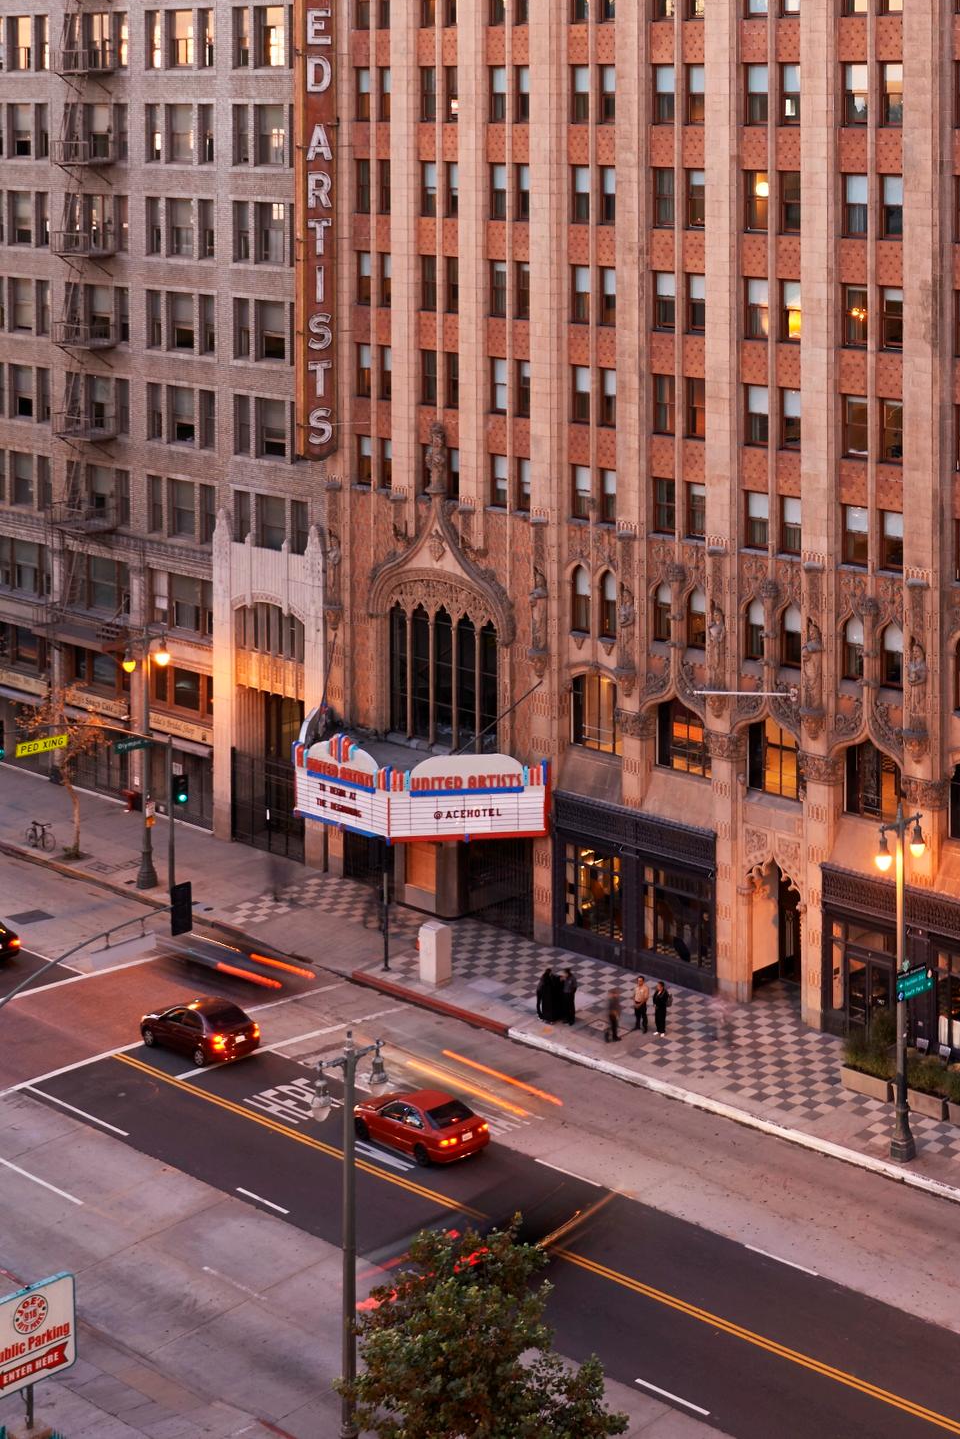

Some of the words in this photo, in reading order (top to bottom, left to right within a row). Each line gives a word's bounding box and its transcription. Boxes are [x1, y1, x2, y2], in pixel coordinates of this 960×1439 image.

[305, 123, 333, 445] ARTISTS
[20, 742, 39, 754] PED
[42, 737, 64, 749] XING
[340, 766, 374, 788] ARTISTS
[411, 775, 463, 791] UNITED
[467, 773, 522, 790] ARTISTS
[17, 1296, 45, 1317] JOE'S
[0, 1341, 26, 1363] ublic
[28, 1322, 70, 1351] Parking
[3, 1363, 33, 1385] ENTER
[35, 1351, 59, 1370] HERE
